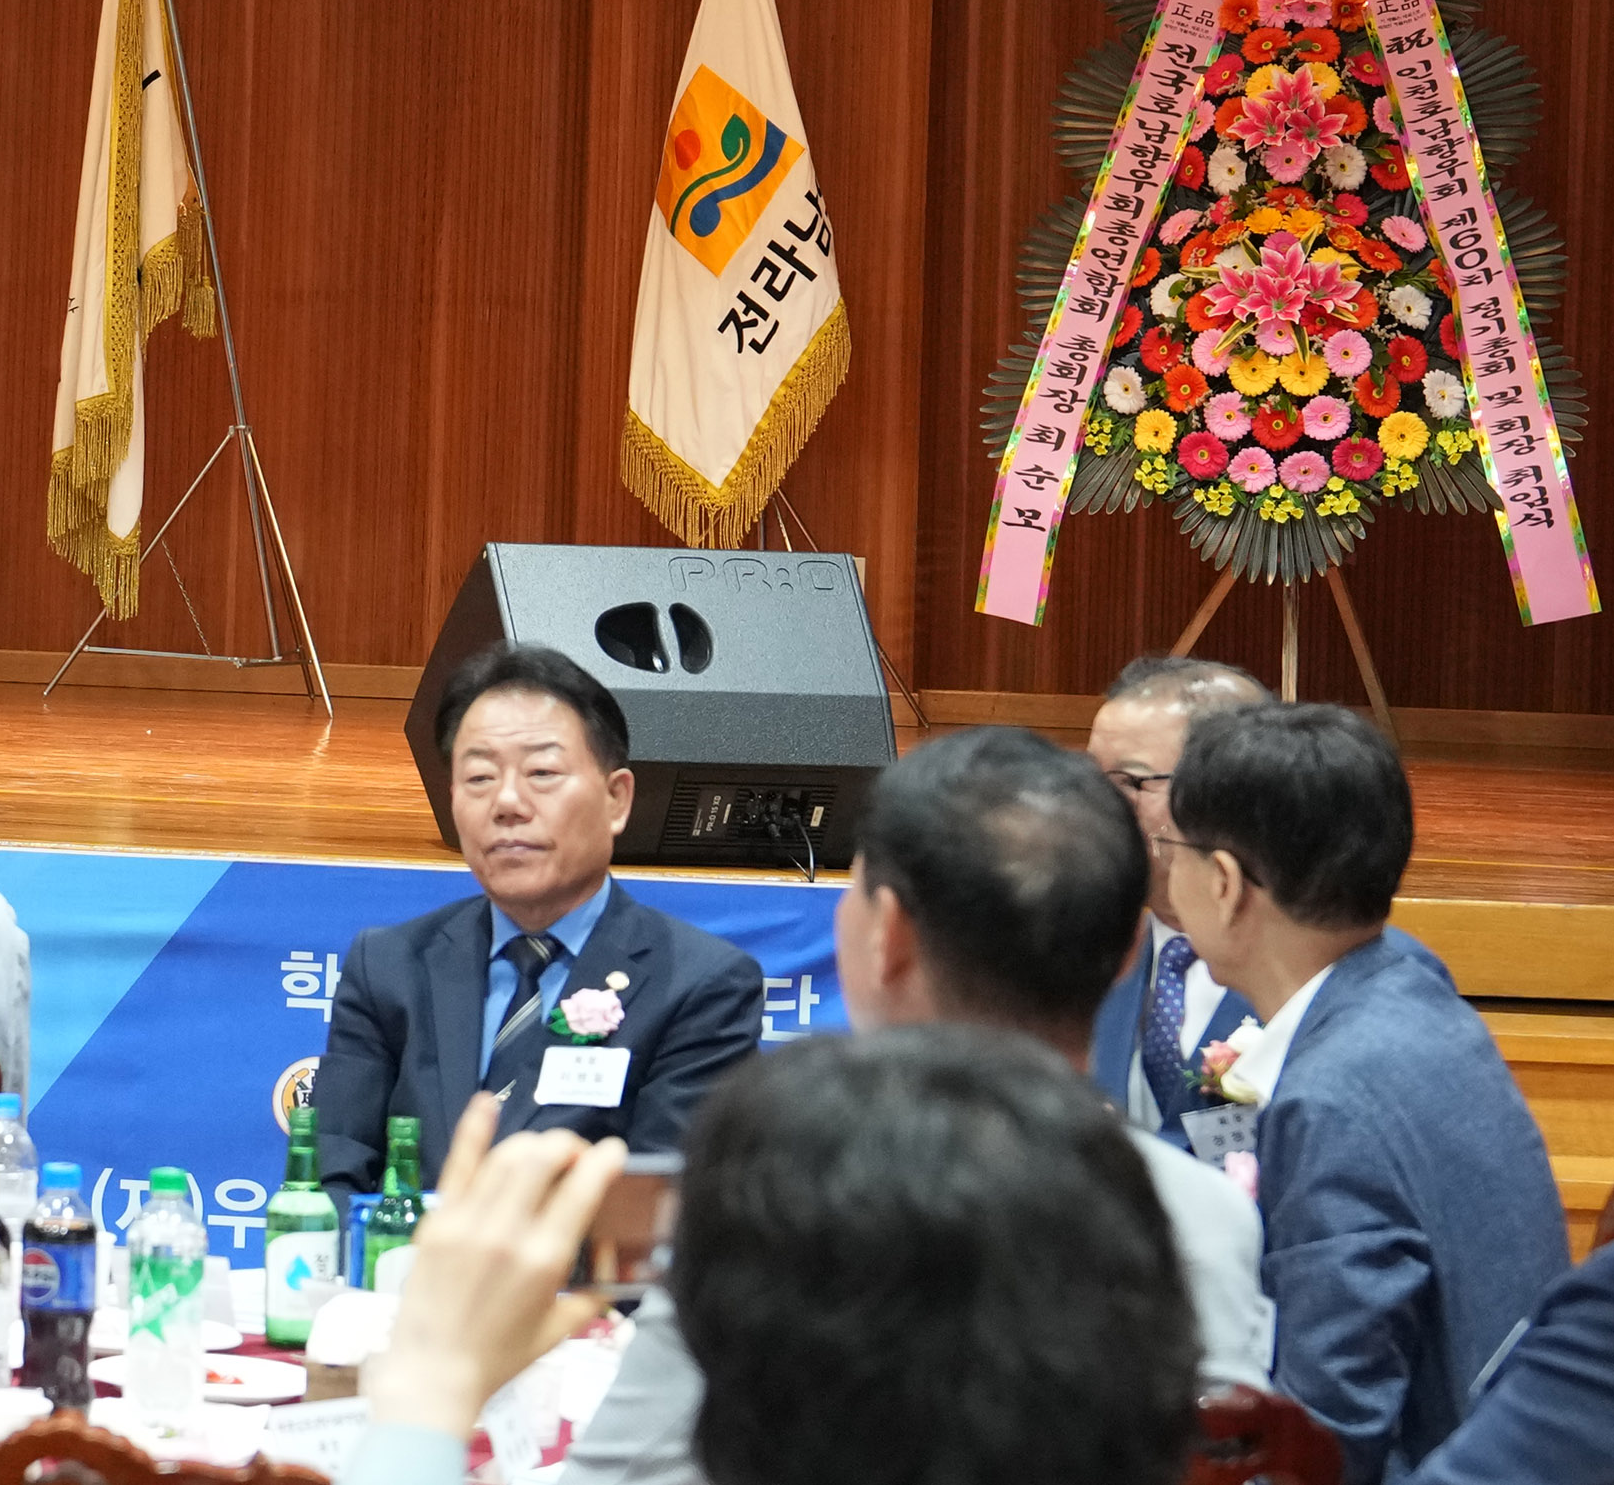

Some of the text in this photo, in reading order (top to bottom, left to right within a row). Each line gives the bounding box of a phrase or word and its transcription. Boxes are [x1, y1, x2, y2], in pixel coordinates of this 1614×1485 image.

[1171, 2, 1215, 27] 正品
[1385, 28, 1434, 54] 祝
[1396, 59, 1469, 202] 인천호남향우회
[1069, 42, 1197, 323] 전국호남향우회총연합회
[1438, 207, 1503, 288] 제60차
[1465, 296, 1518, 378] 정기총회
[1039, 334, 1100, 414] 총회장
[1483, 385, 1524, 409] 및
[1025, 423, 1067, 452] 최
[1488, 415, 1546, 456] 회장
[1014, 464, 1060, 491] 순
[1002, 506, 1047, 533] 모
